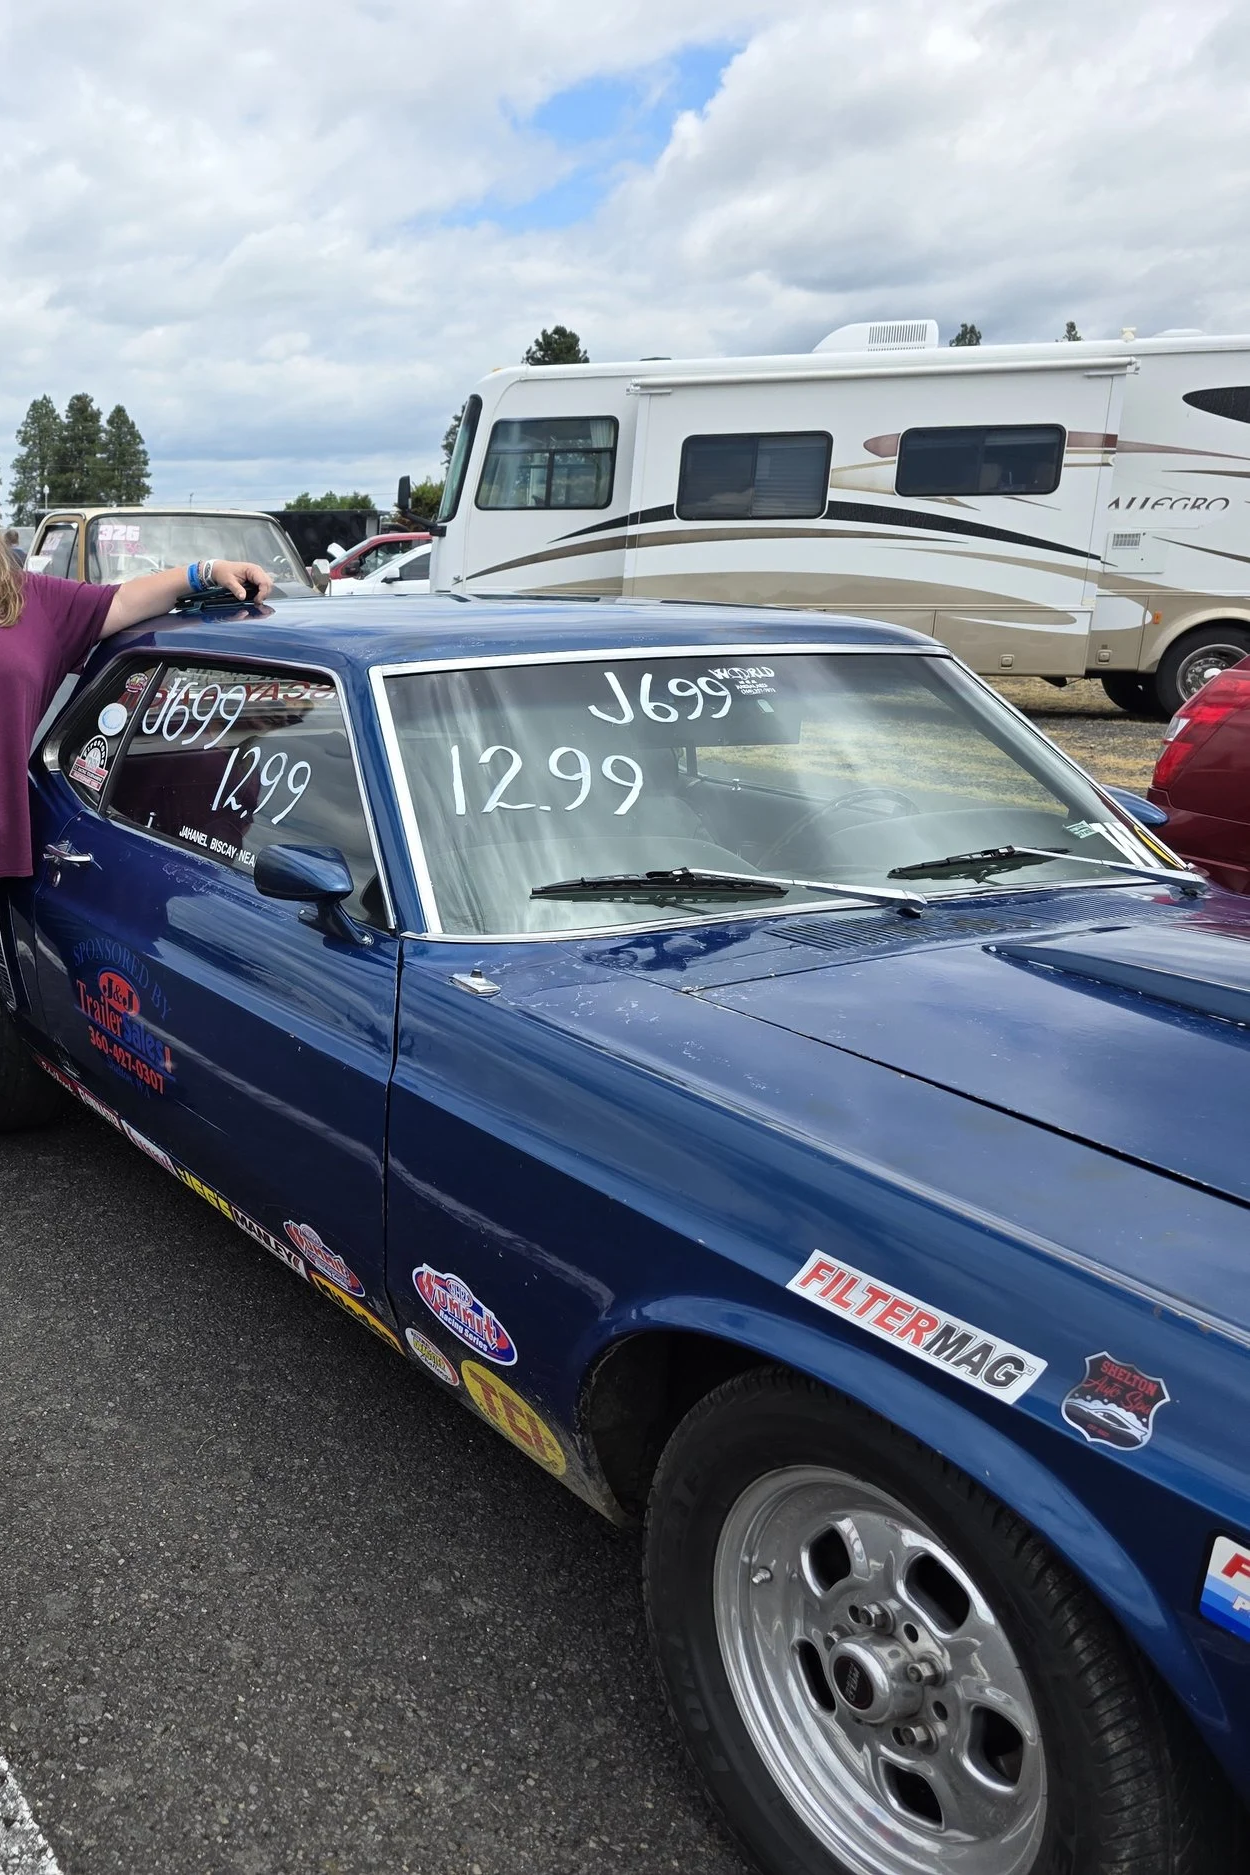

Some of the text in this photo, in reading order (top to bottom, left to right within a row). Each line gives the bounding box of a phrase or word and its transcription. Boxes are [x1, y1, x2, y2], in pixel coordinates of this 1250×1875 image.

[1107, 496, 1230, 511] ALLEGRO
[98, 525, 140, 541] 326
[142, 677, 247, 750] J699
[588, 671, 732, 725] J699
[211, 746, 311, 825] 12.99
[450, 744, 643, 816] 12.99
[179, 825, 257, 868] JAHANEL BISCAY-NEA
[74, 938, 172, 1021] SPONSORED BY
[102, 976, 134, 1012] J&J
[88, 1025, 165, 1095] 360-427-0307
[233, 1207, 295, 1268] MANLEY
[439, 1311, 464, 1335] Racing
[464, 1328, 489, 1353] Series
[796, 1258, 1030, 1389] FILTERMAG
[1082, 1375, 1152, 1415] Auto Spa
[1100, 1360, 1158, 1397] SHELTON
[467, 1366, 548, 1458] TCI
